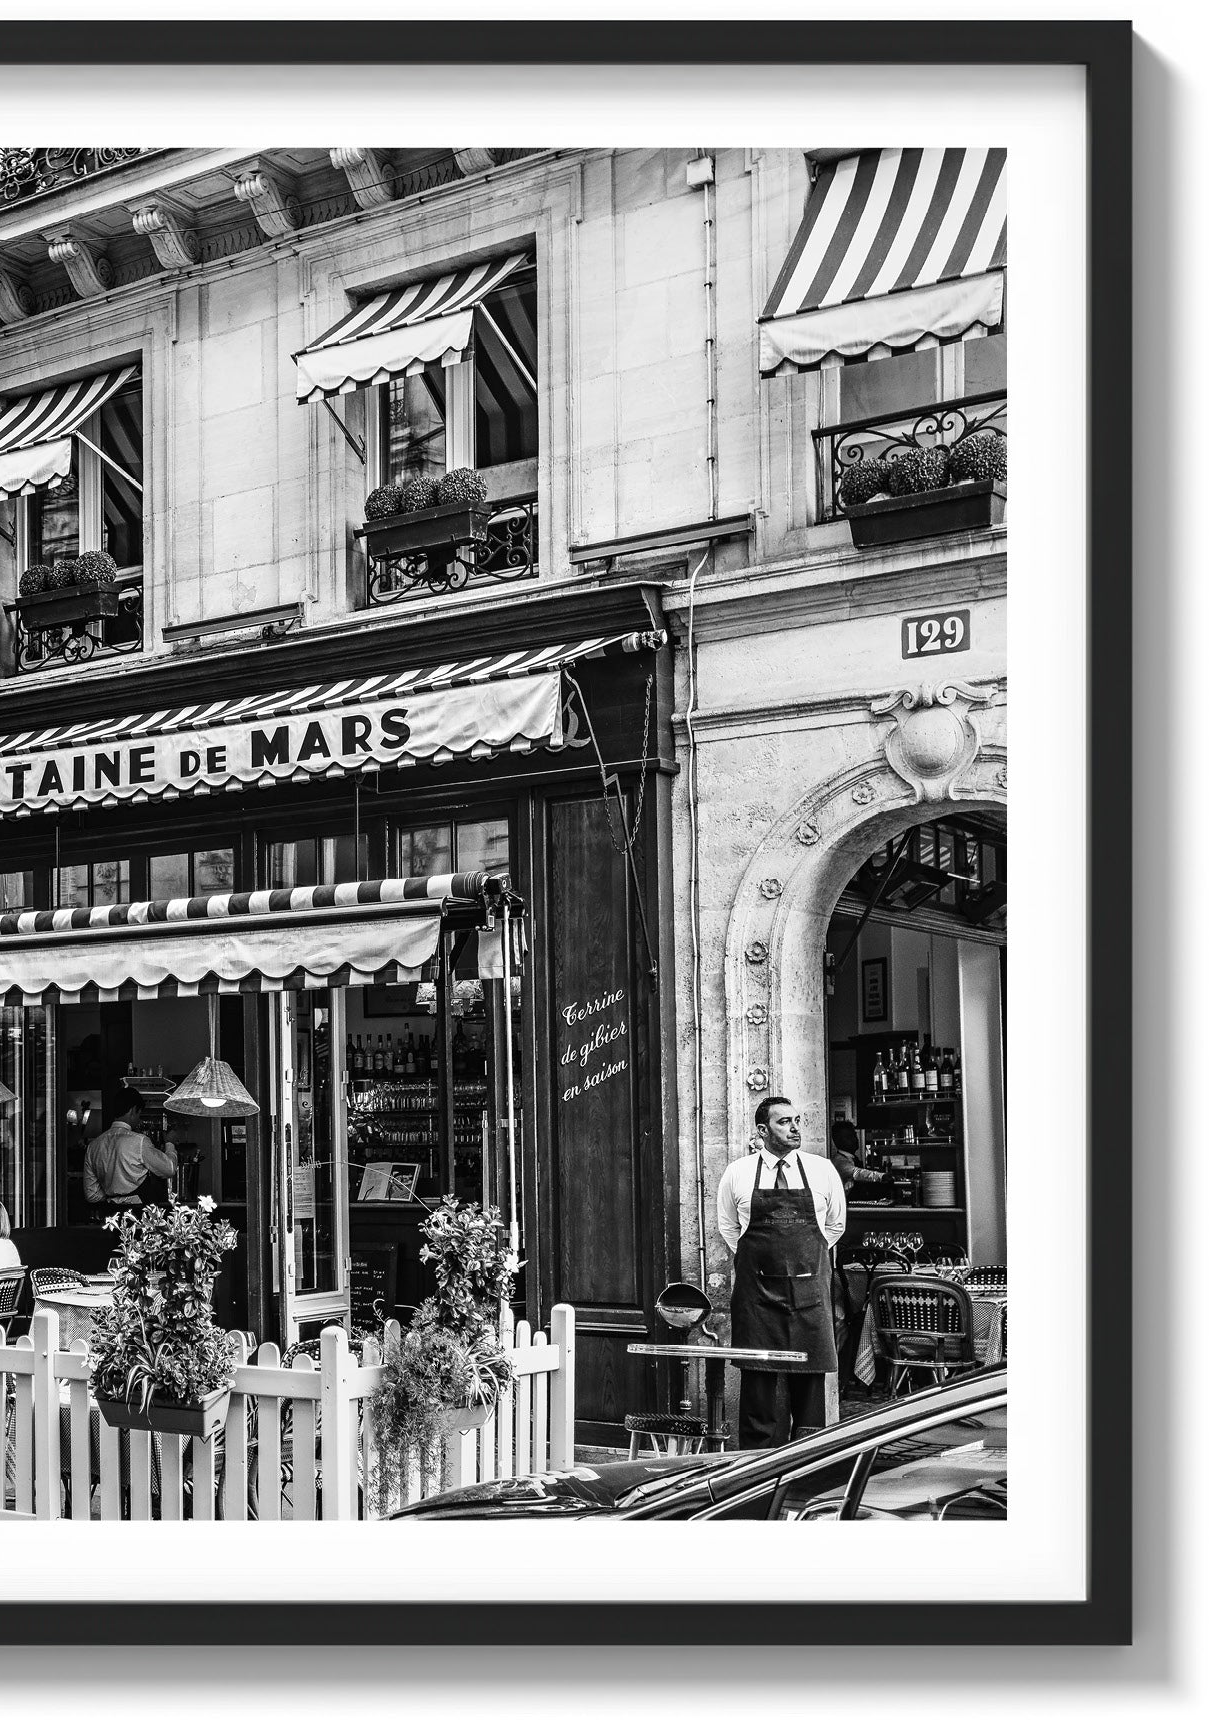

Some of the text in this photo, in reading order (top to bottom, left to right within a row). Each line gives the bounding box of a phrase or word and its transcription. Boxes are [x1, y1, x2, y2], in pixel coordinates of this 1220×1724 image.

[907, 616, 964, 654] 129
[180, 745, 227, 778] DE
[251, 708, 411, 768] MARS
[562, 989, 625, 1026] Terrine
[561, 1021, 628, 1067] de gibier
[562, 1060, 628, 1102] en saison
